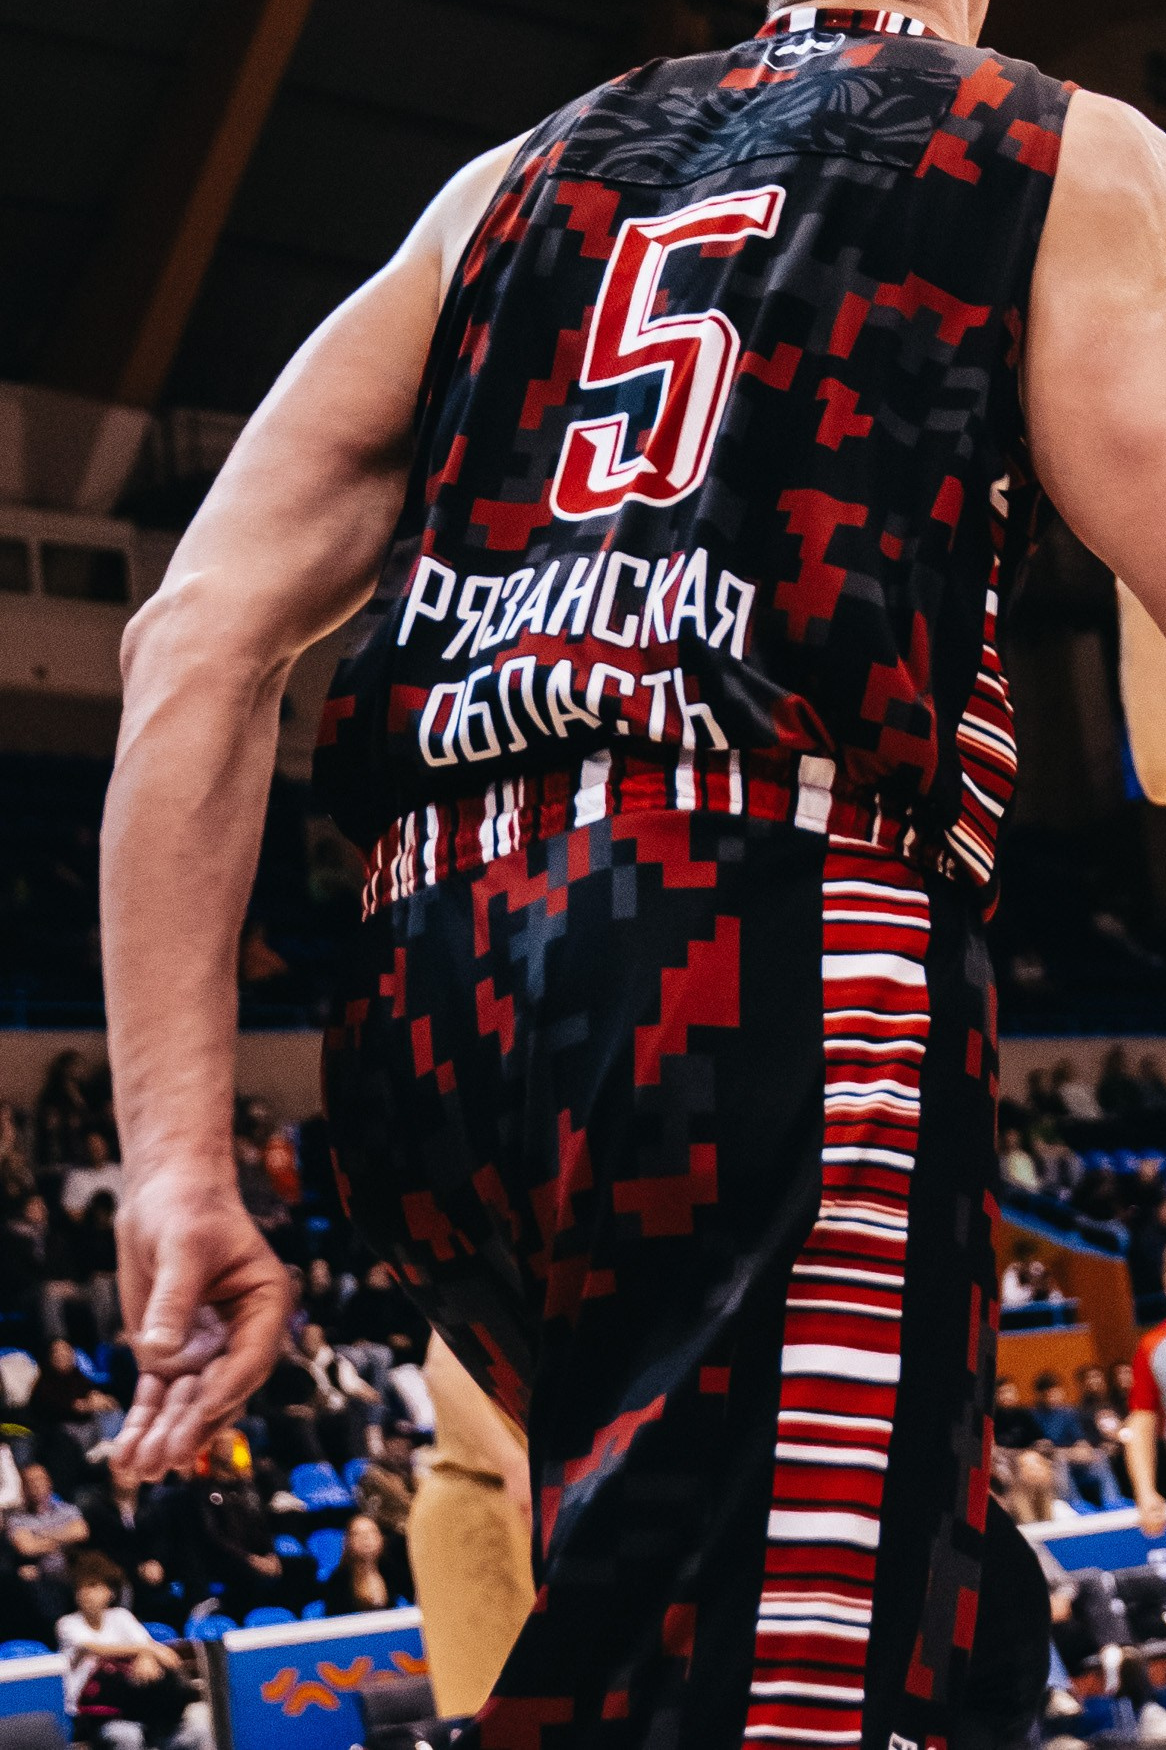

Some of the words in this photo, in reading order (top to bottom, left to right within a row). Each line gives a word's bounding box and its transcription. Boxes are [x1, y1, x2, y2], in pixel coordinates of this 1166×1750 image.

[549, 184, 787, 522] 5
[396, 546, 756, 661] РЯЗАНСКАЯ
[418, 654, 729, 768] ОБЛАСТЬ
